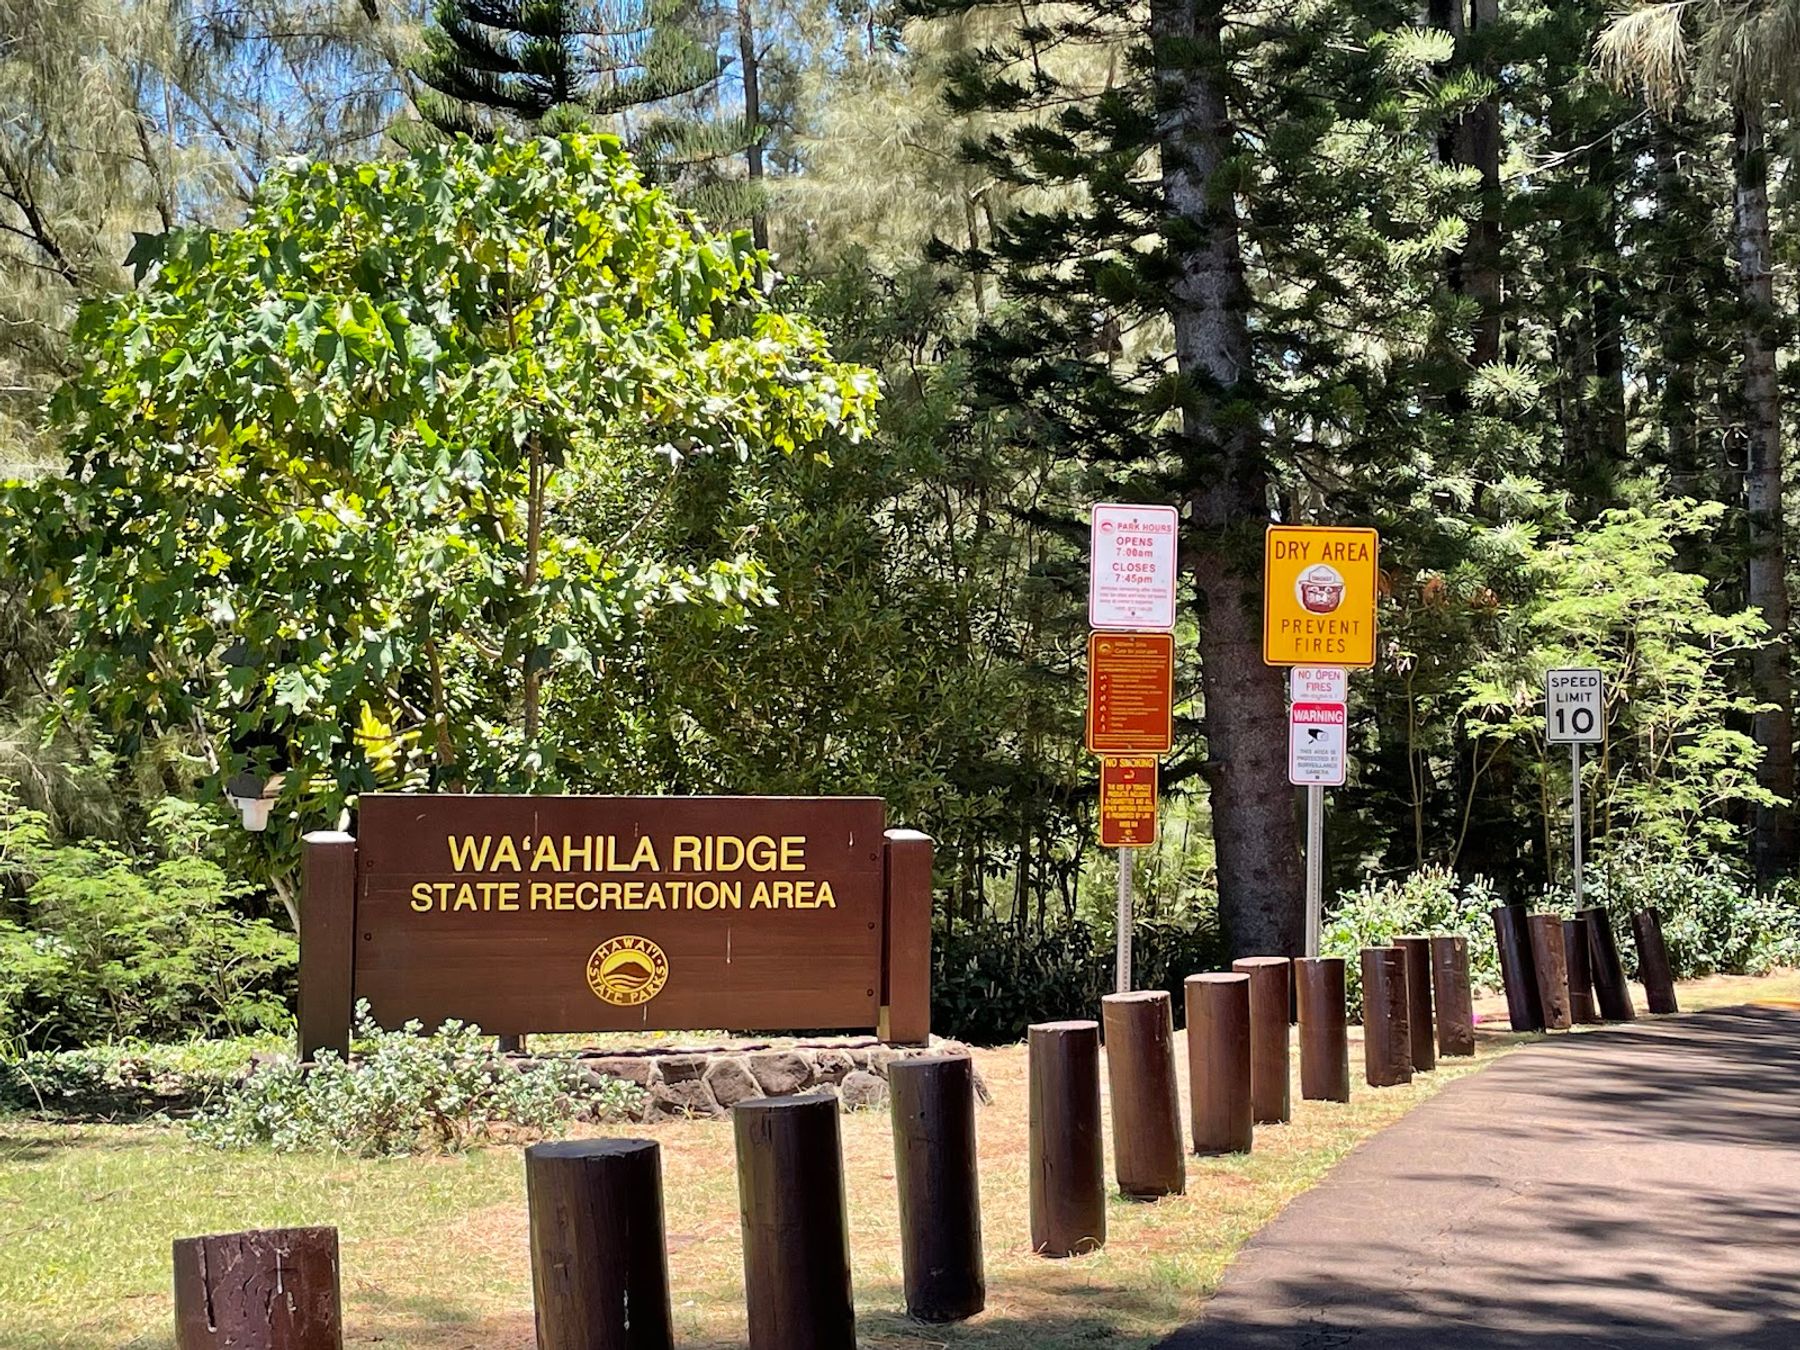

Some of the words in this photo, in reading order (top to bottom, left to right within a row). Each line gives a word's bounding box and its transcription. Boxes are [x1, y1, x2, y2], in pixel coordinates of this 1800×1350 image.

[1117, 523, 1140, 532] PARK
[1142, 523, 1172, 533] HOURS
[1116, 536, 1153, 547] OPENS
[1275, 541, 1310, 560] DRY
[1321, 542, 1369, 561] AREA
[1112, 562, 1156, 573] CLOSES
[1281, 619, 1360, 635] PREVENT
[1294, 637, 1346, 653] FIRES
[1298, 670, 1311, 680] NO
[1315, 670, 1340, 681] OPEN
[1551, 676, 1598, 688] SPEED
[1306, 682, 1332, 692] FIRES
[1556, 692, 1592, 703] LIMIT
[1293, 709, 1343, 723] WARNING
[1555, 707, 1595, 734] 10
[1105, 758, 1117, 768] NO
[1119, 758, 1154, 769] SMOKING
[673, 836, 807, 872] RIDGE
[410, 882, 520, 912] STATE
[530, 882, 742, 911] RECREATION
[749, 881, 837, 909] AREA
[589, 967, 624, 1004] STATE
[630, 965, 667, 1004] PARKS
